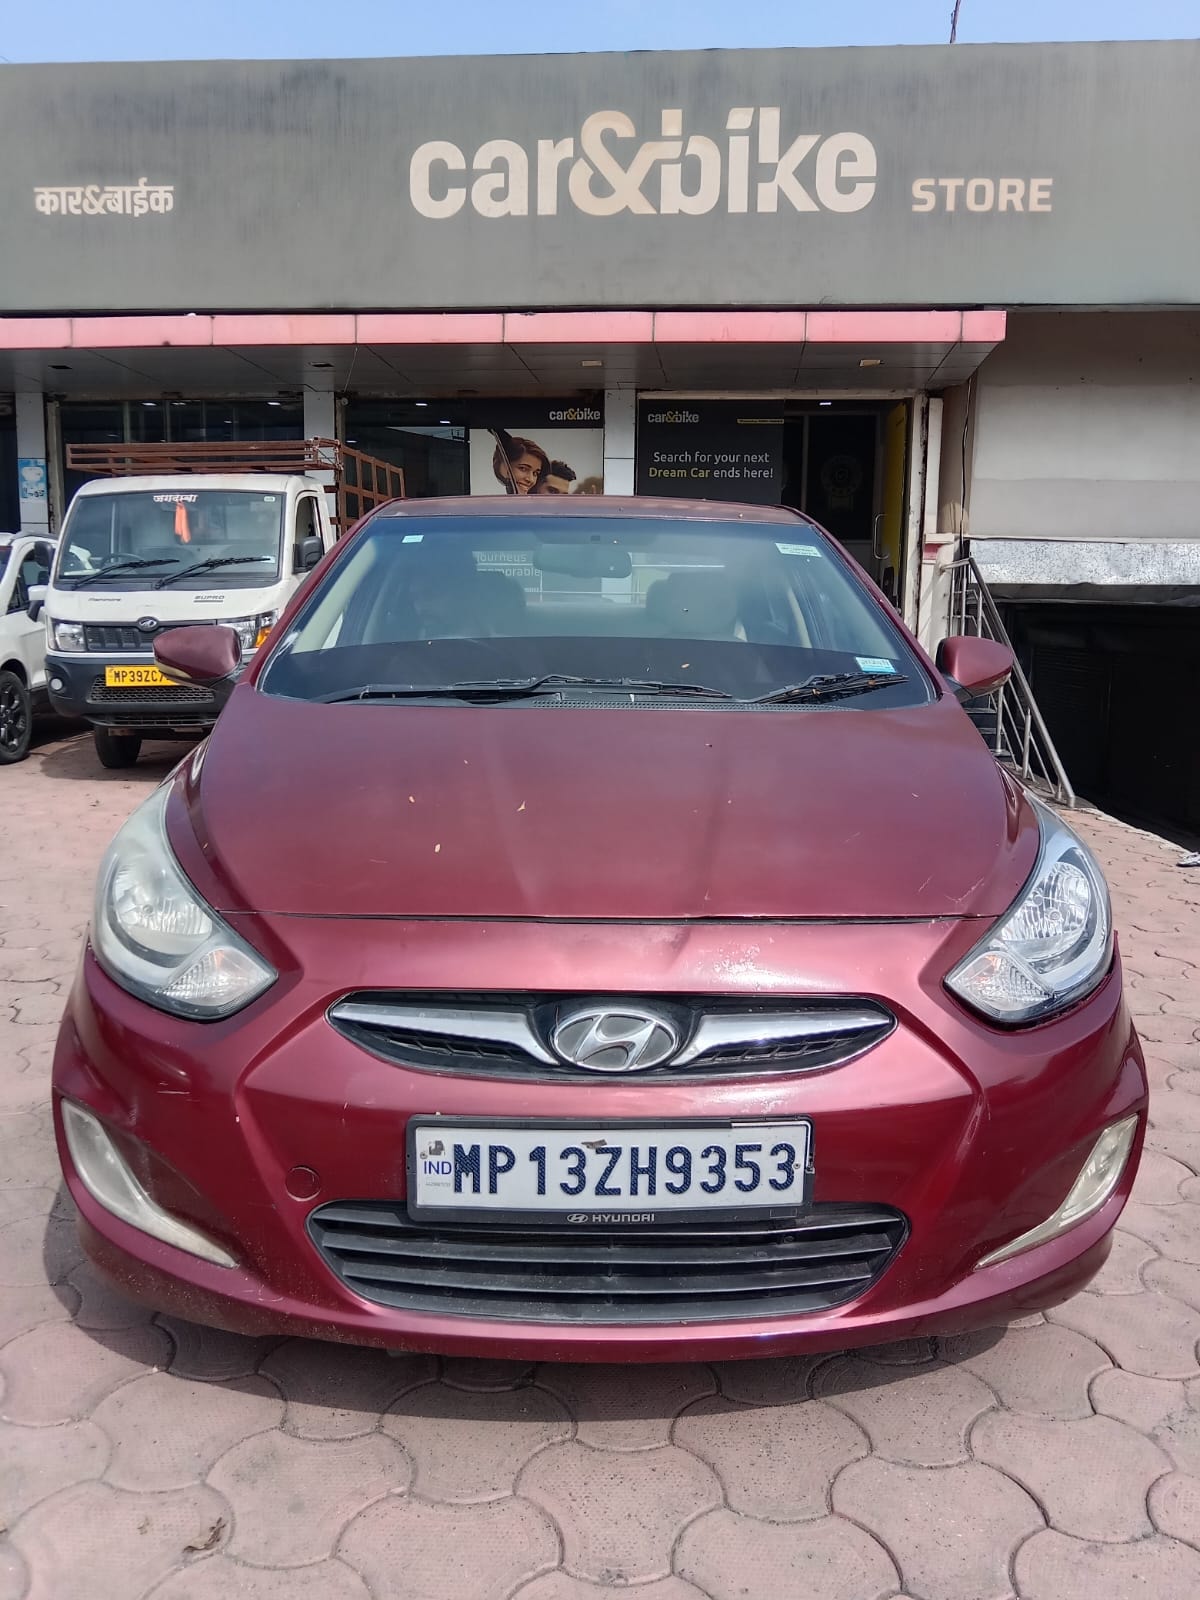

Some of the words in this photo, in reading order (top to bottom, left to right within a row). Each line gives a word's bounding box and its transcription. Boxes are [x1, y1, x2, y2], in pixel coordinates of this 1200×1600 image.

[409, 107, 877, 218] car&bike
[33, 177, 175, 217] कार&बाईक
[911, 177, 1053, 213] STORE
[549, 408, 600, 421] car&bike
[647, 410, 700, 424] car&bike
[653, 451, 692, 463] Search
[694, 451, 712, 463] for
[713, 453, 741, 465] your
[743, 452, 770, 463] next
[648, 467, 687, 478] Dream
[690, 467, 711, 478] Car
[713, 467, 741, 478] ends
[743, 467, 774, 478] here!
[423, 1160, 452, 1175] IND
[592, 1213, 655, 1223] HYUNDAI
